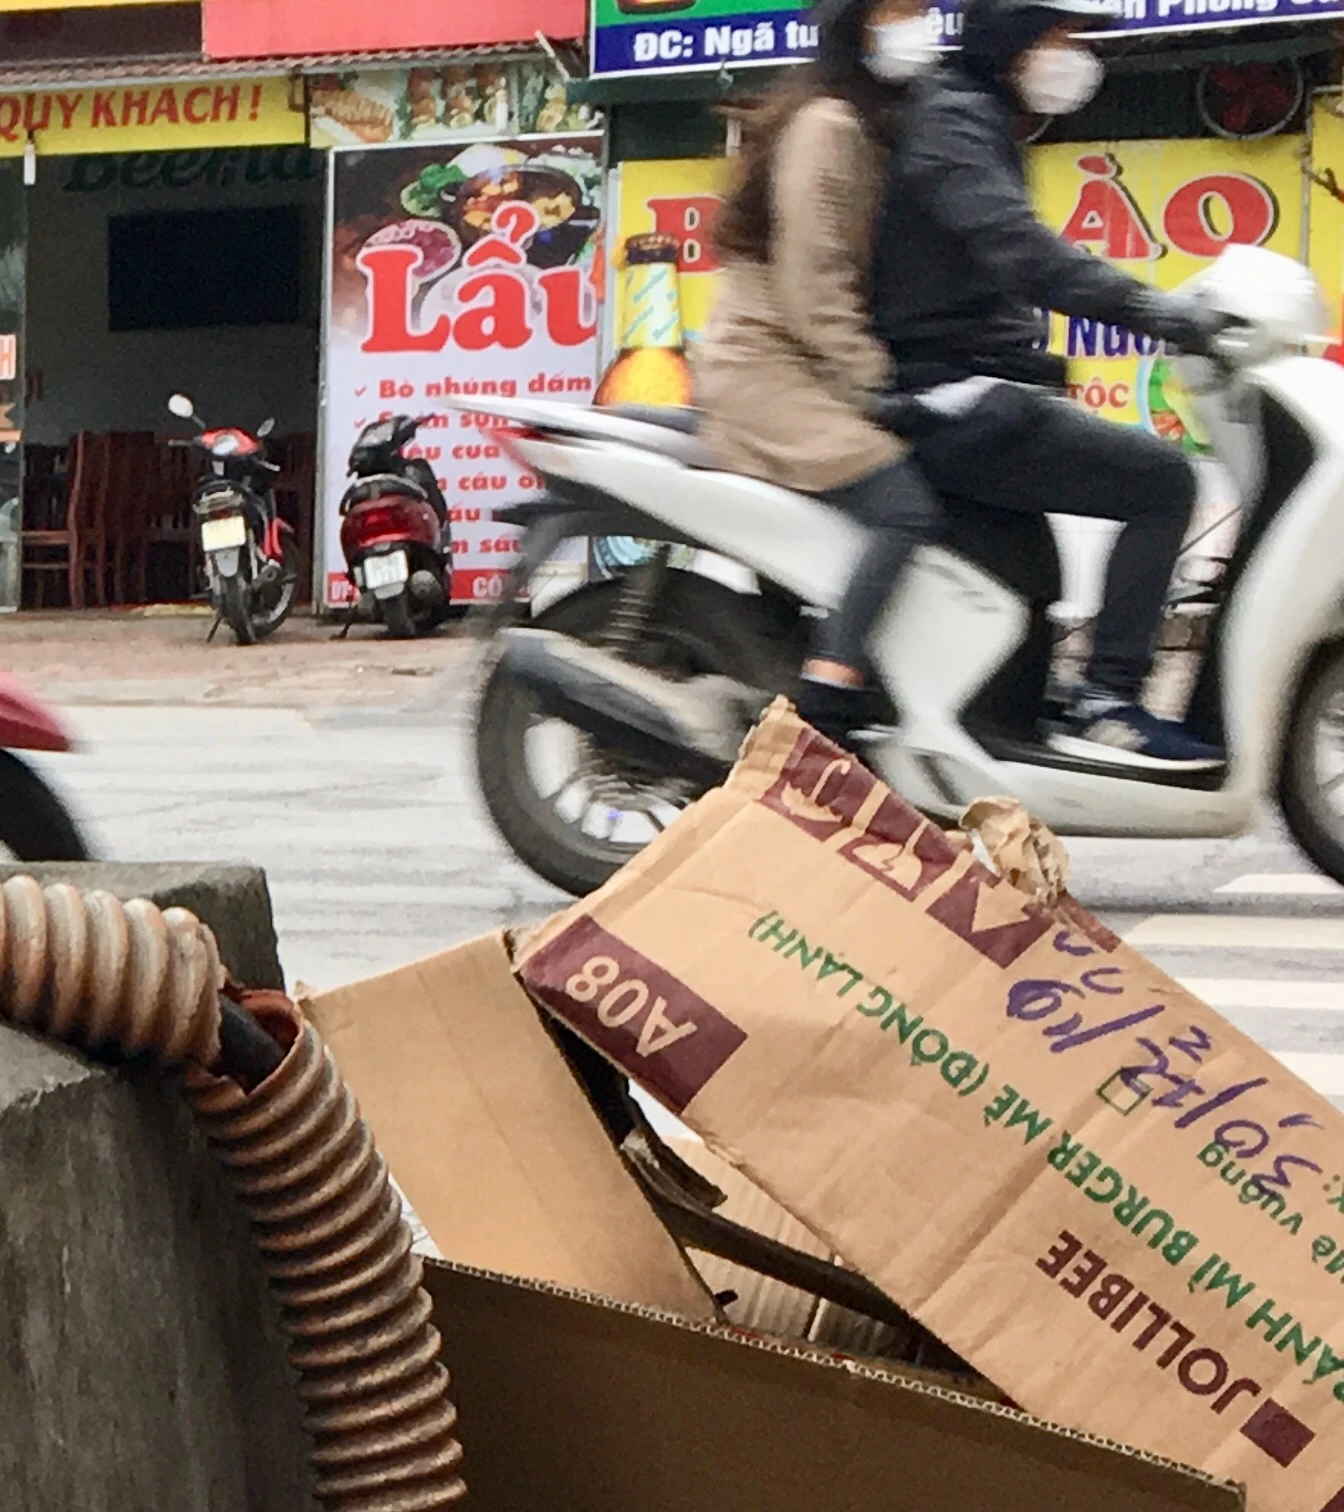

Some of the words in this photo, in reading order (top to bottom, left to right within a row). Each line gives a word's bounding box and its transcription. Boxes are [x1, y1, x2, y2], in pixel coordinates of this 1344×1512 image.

[633, 31, 694, 62] ĐC:
[704, 21, 775, 57] Ngã
[359, 204, 598, 353] Lẩu
[451, 445, 501, 460] cua
[748, 909, 864, 998] LẠNH)
[565, 955, 698, 1058] A08
[856, 985, 990, 1097] (ĐÔNG
[983, 1083, 1054, 1146] MÈ
[1046, 1130, 1200, 1267] BURGER
[1035, 1229, 1262, 1415] JOLLIBEE
[1187, 1253, 1257, 1309] MÌ
